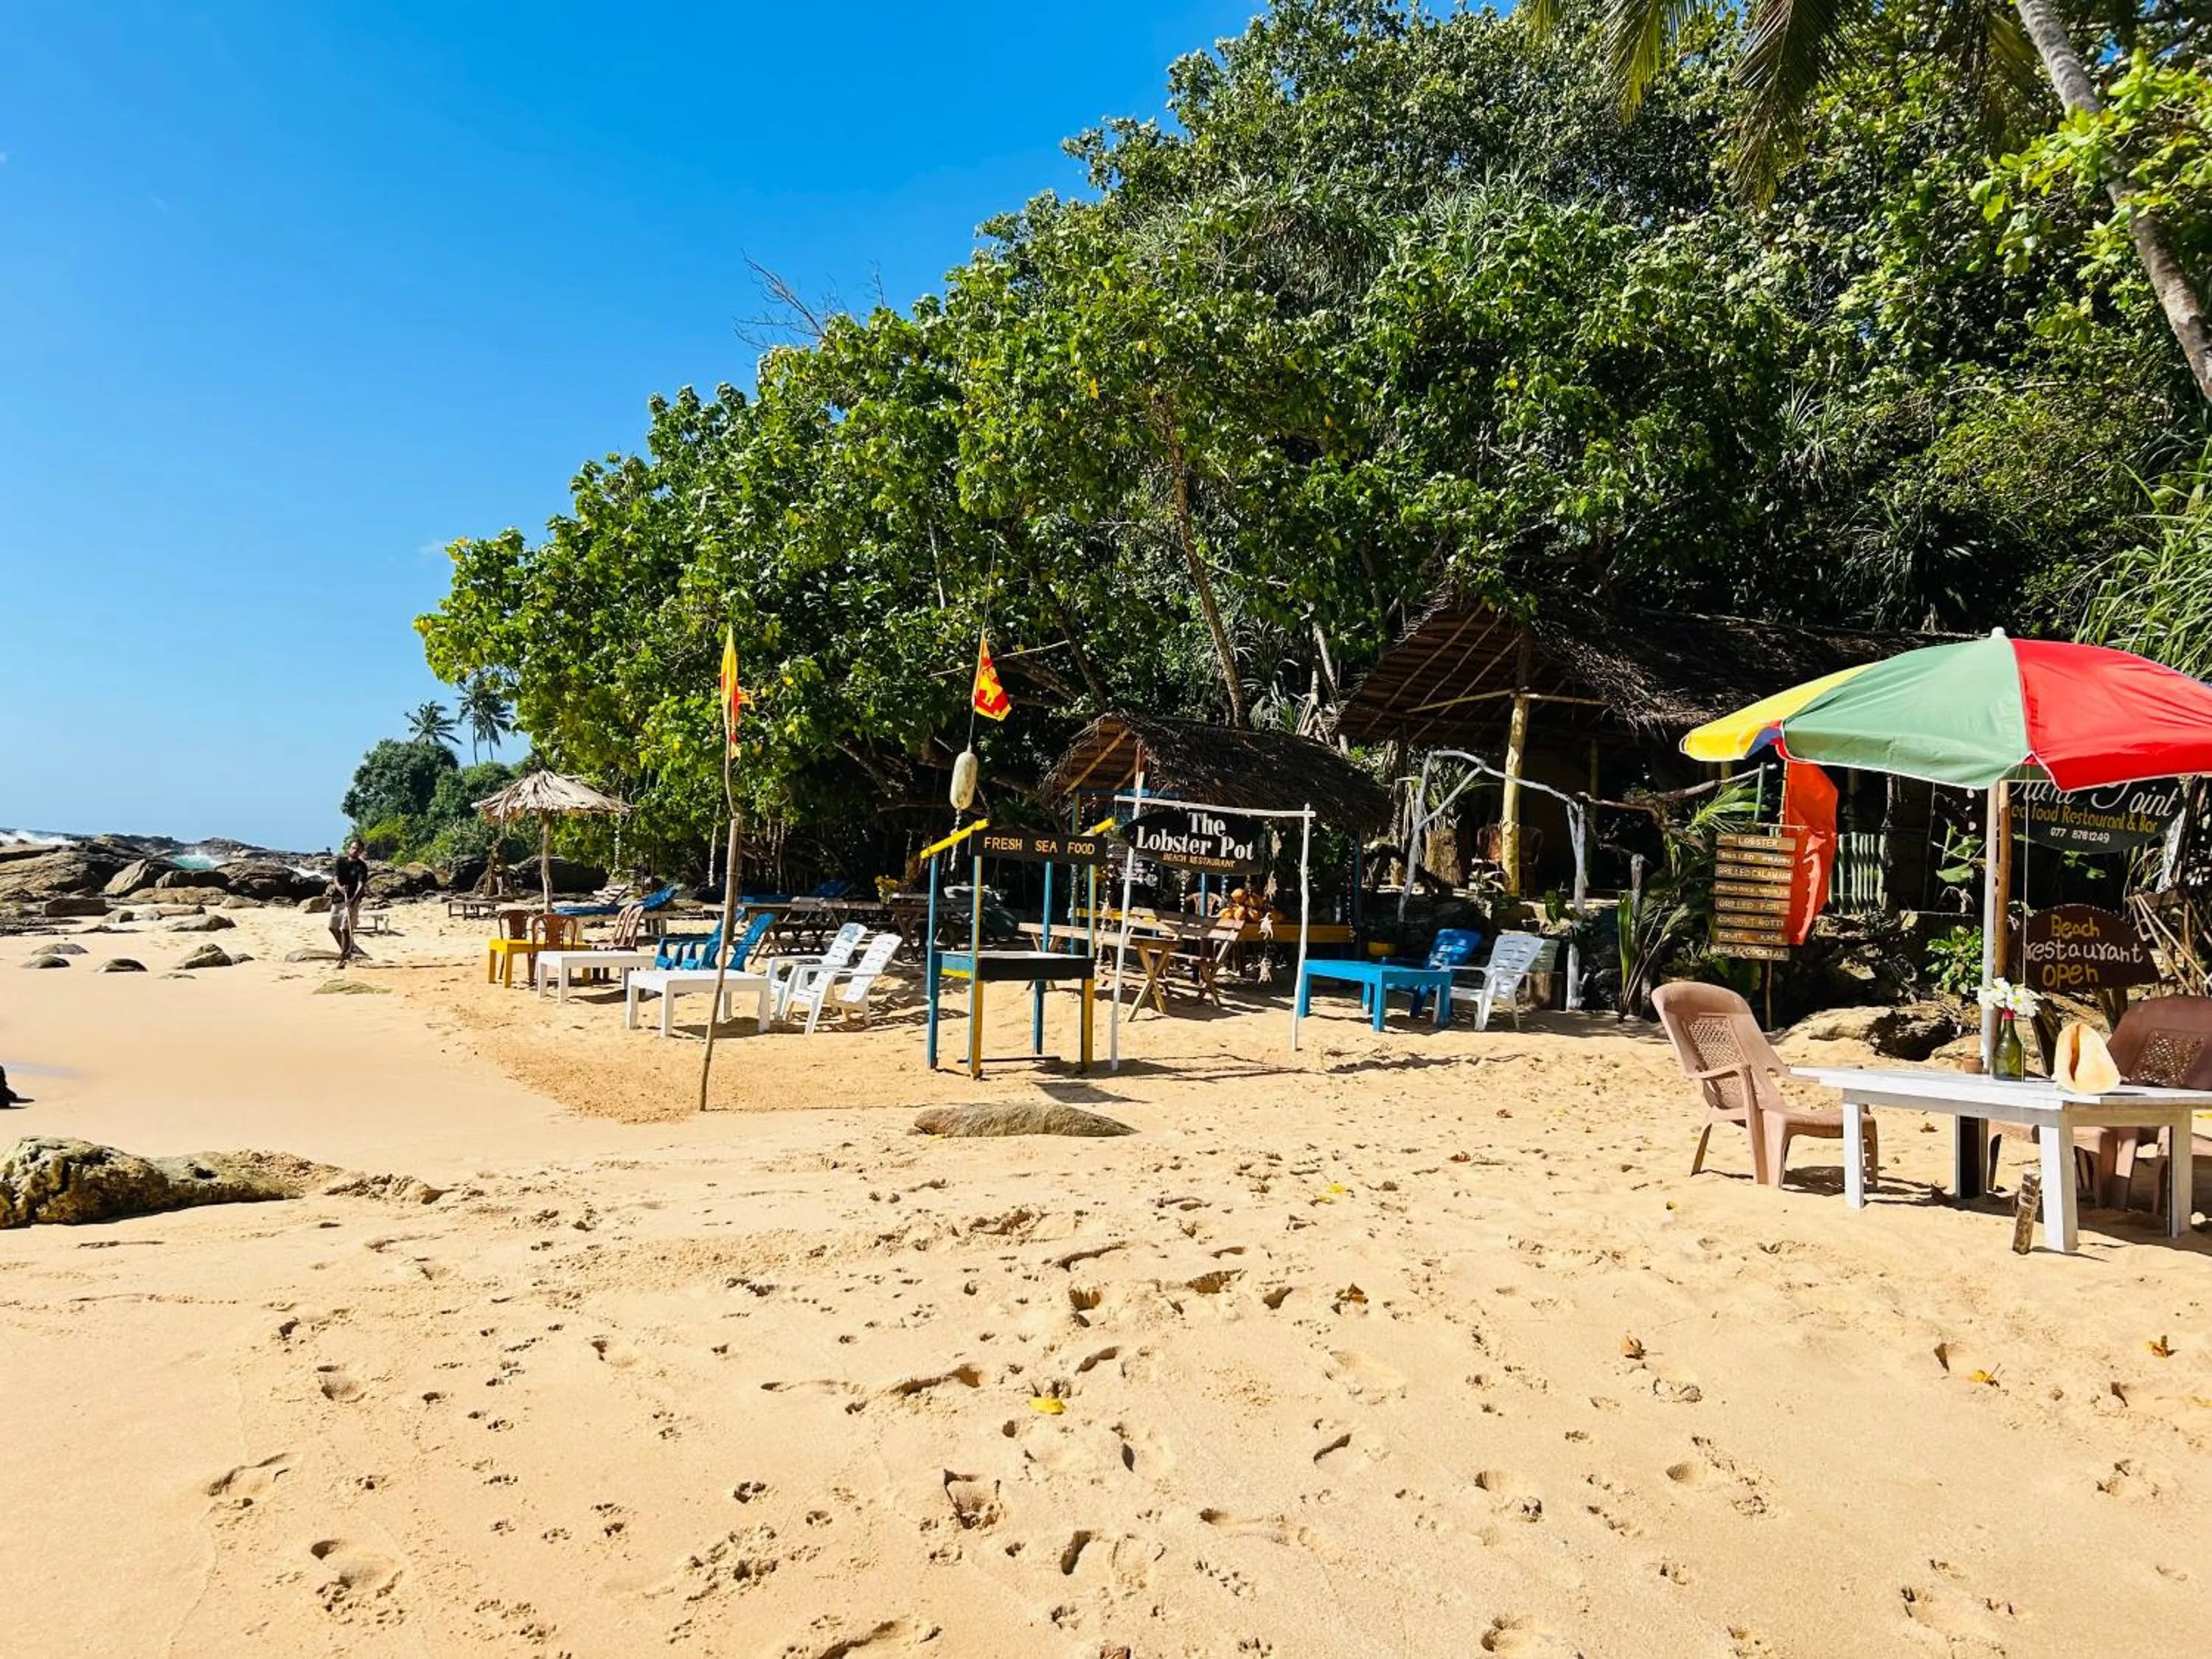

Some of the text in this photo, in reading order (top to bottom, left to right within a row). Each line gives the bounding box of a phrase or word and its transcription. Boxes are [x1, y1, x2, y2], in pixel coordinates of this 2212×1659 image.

[1189, 811, 1226, 838] The
[2031, 802, 2059, 822] food
[2062, 805, 2126, 830] Restaurant
[2126, 813, 2137, 831] &
[2138, 813, 2159, 835] Bar
[984, 836, 1096, 855] FRESH SEA FOOD
[1135, 825, 1255, 861] Lobster Pot
[1738, 837, 1778, 847] LOBSTER
[1162, 853, 1237, 869] BEACH RESTAURANT
[2050, 914, 2100, 939] Beach
[2025, 939, 2143, 963] restaurant
